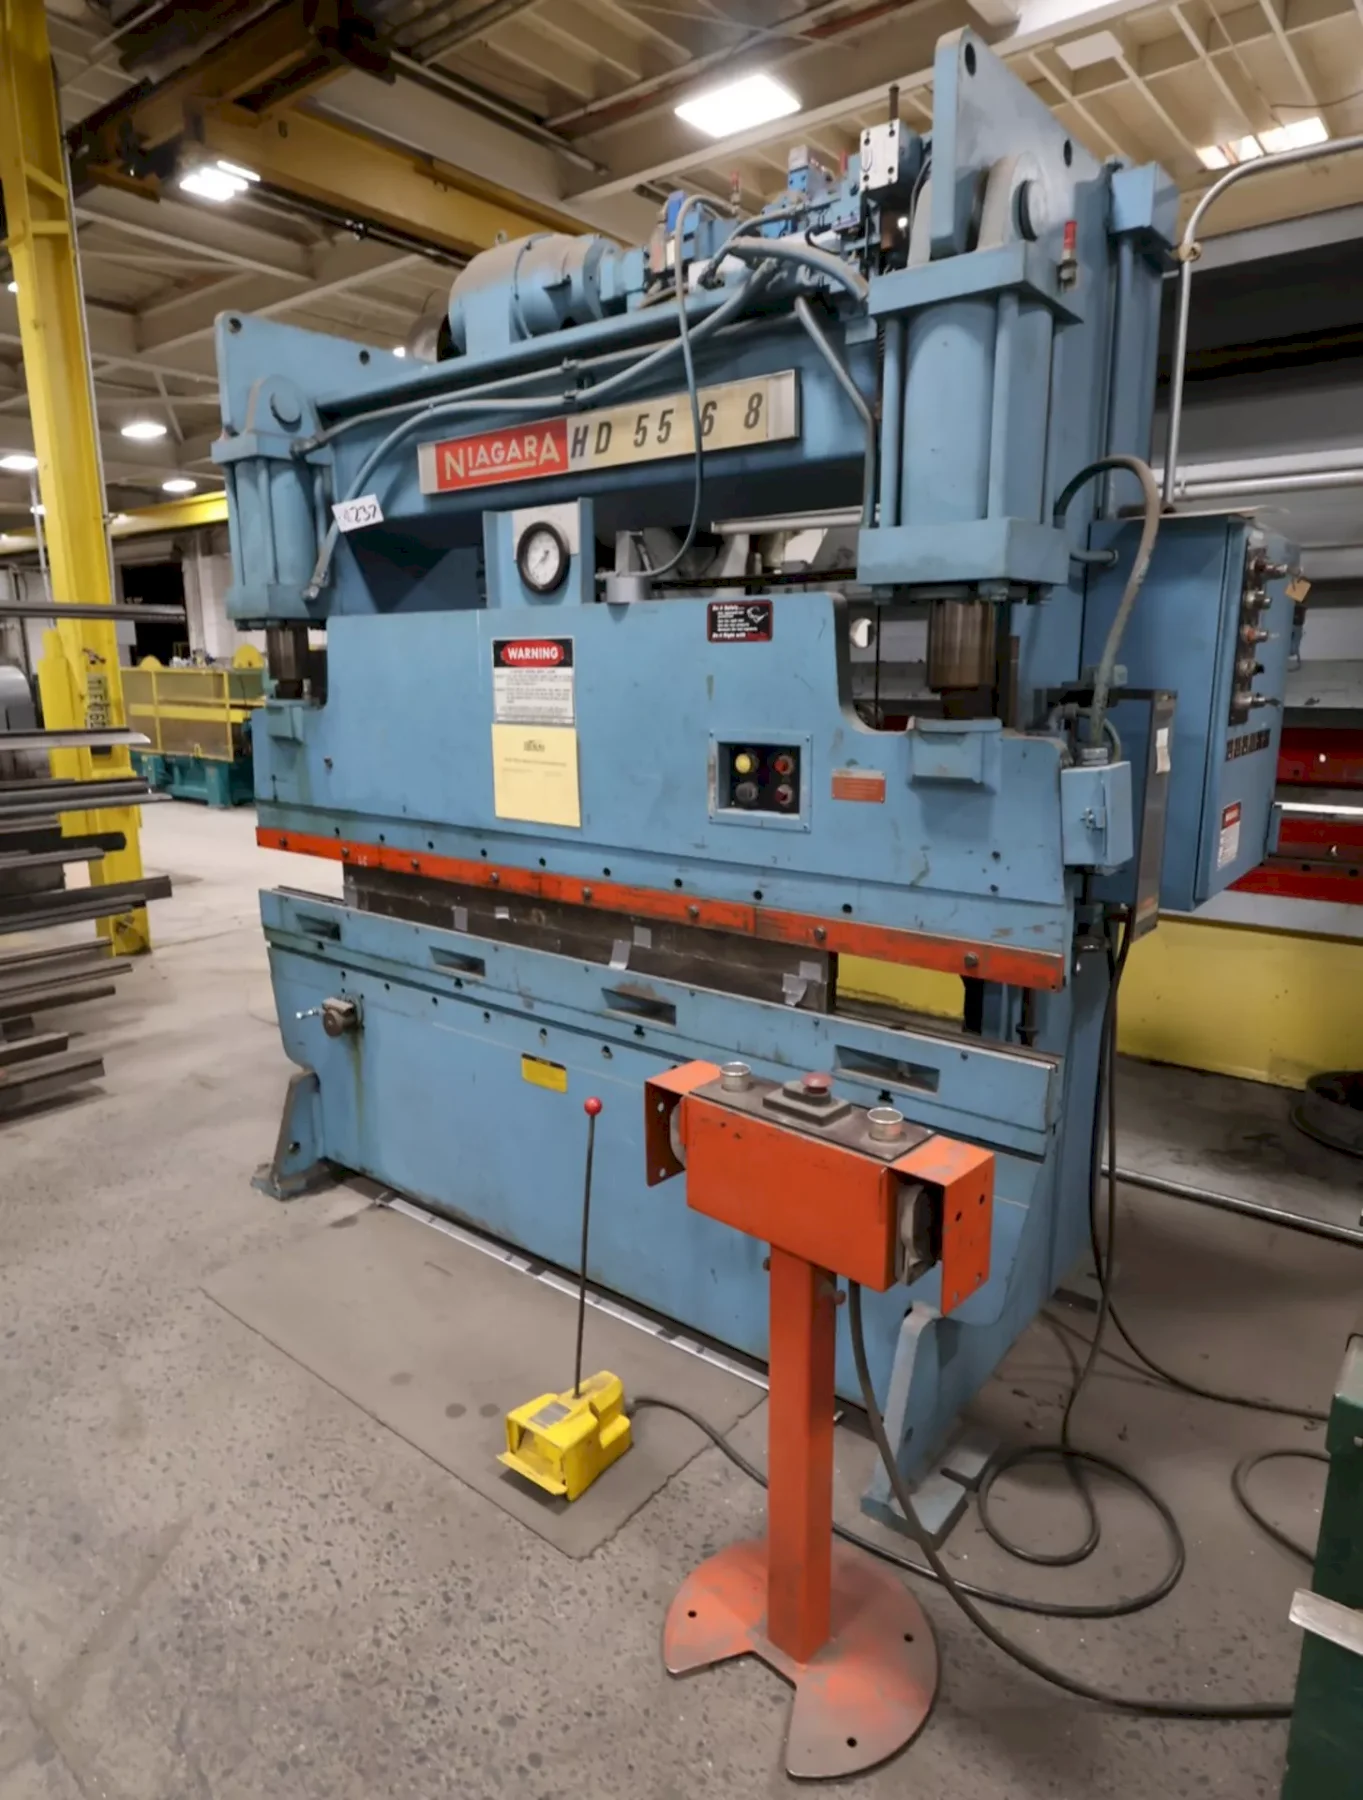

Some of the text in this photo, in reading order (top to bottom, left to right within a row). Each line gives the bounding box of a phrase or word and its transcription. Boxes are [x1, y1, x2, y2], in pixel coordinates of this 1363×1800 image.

[571, 392, 763, 459] HD 55 6 8
[444, 432, 561, 481] NIAGARA
[507, 646, 558, 660] WARNING
